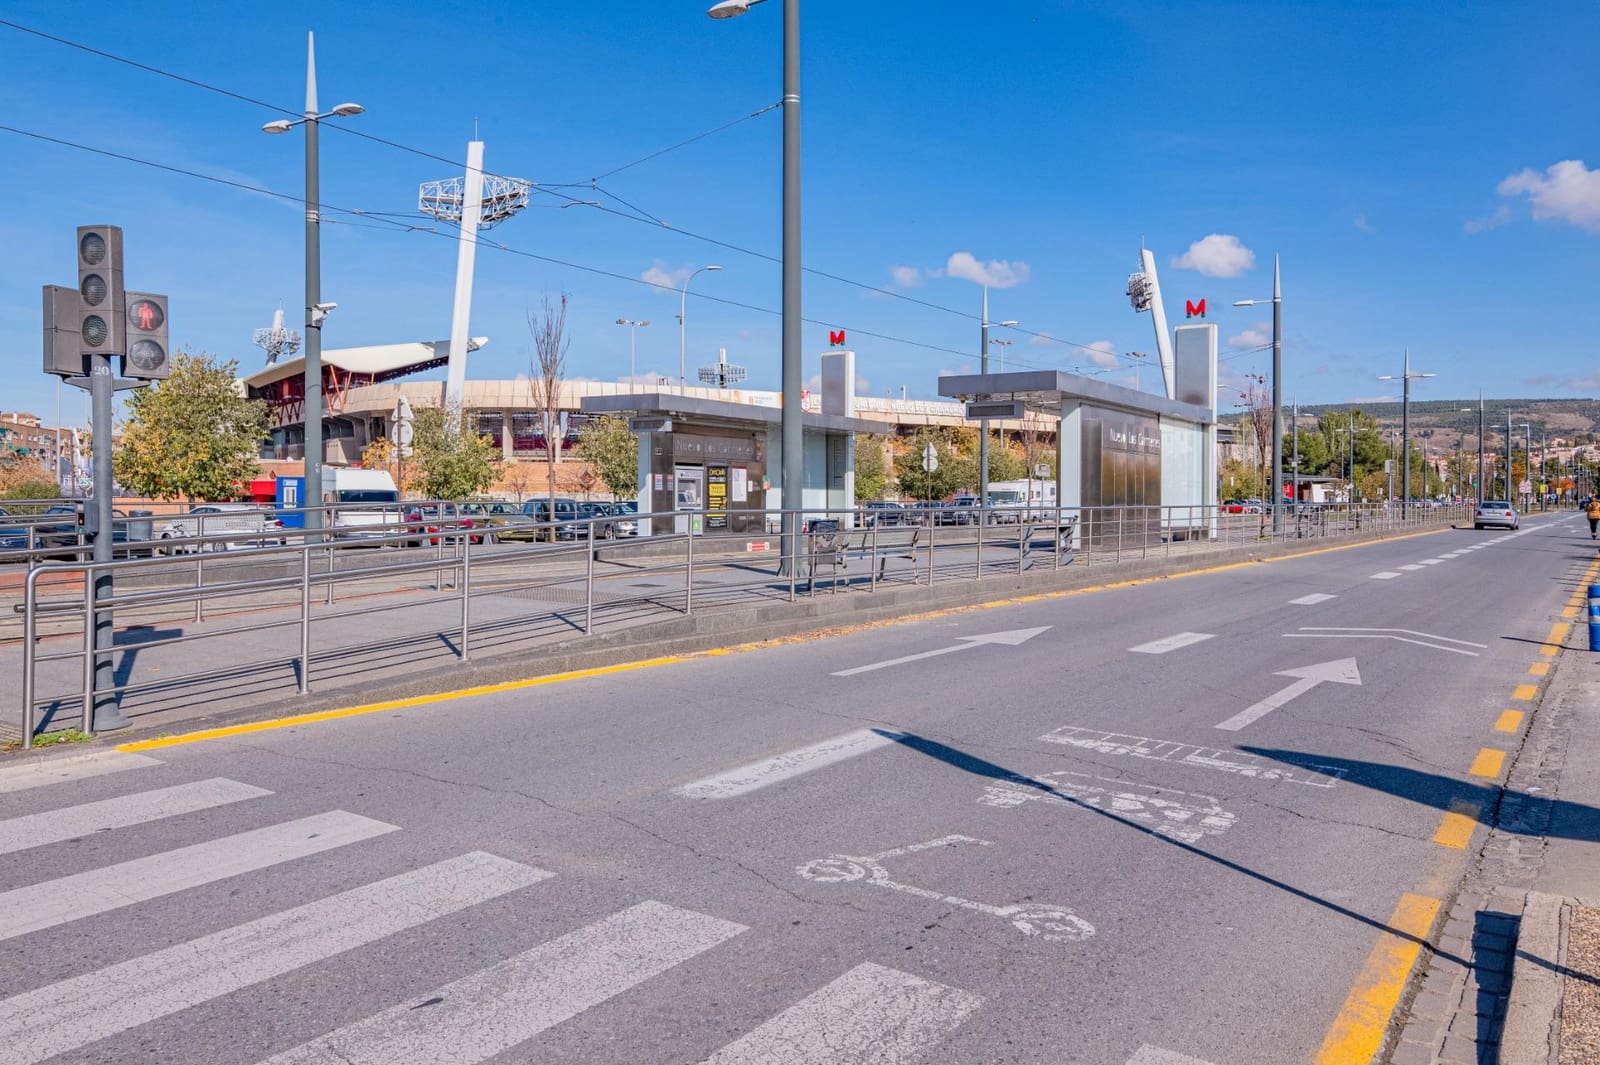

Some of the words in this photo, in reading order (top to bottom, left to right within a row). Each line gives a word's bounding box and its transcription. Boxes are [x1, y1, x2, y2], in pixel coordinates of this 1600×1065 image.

[1186, 298, 1207, 318] M
[1110, 427, 1126, 444] Nuevo
[1128, 431, 1137, 445] Los
